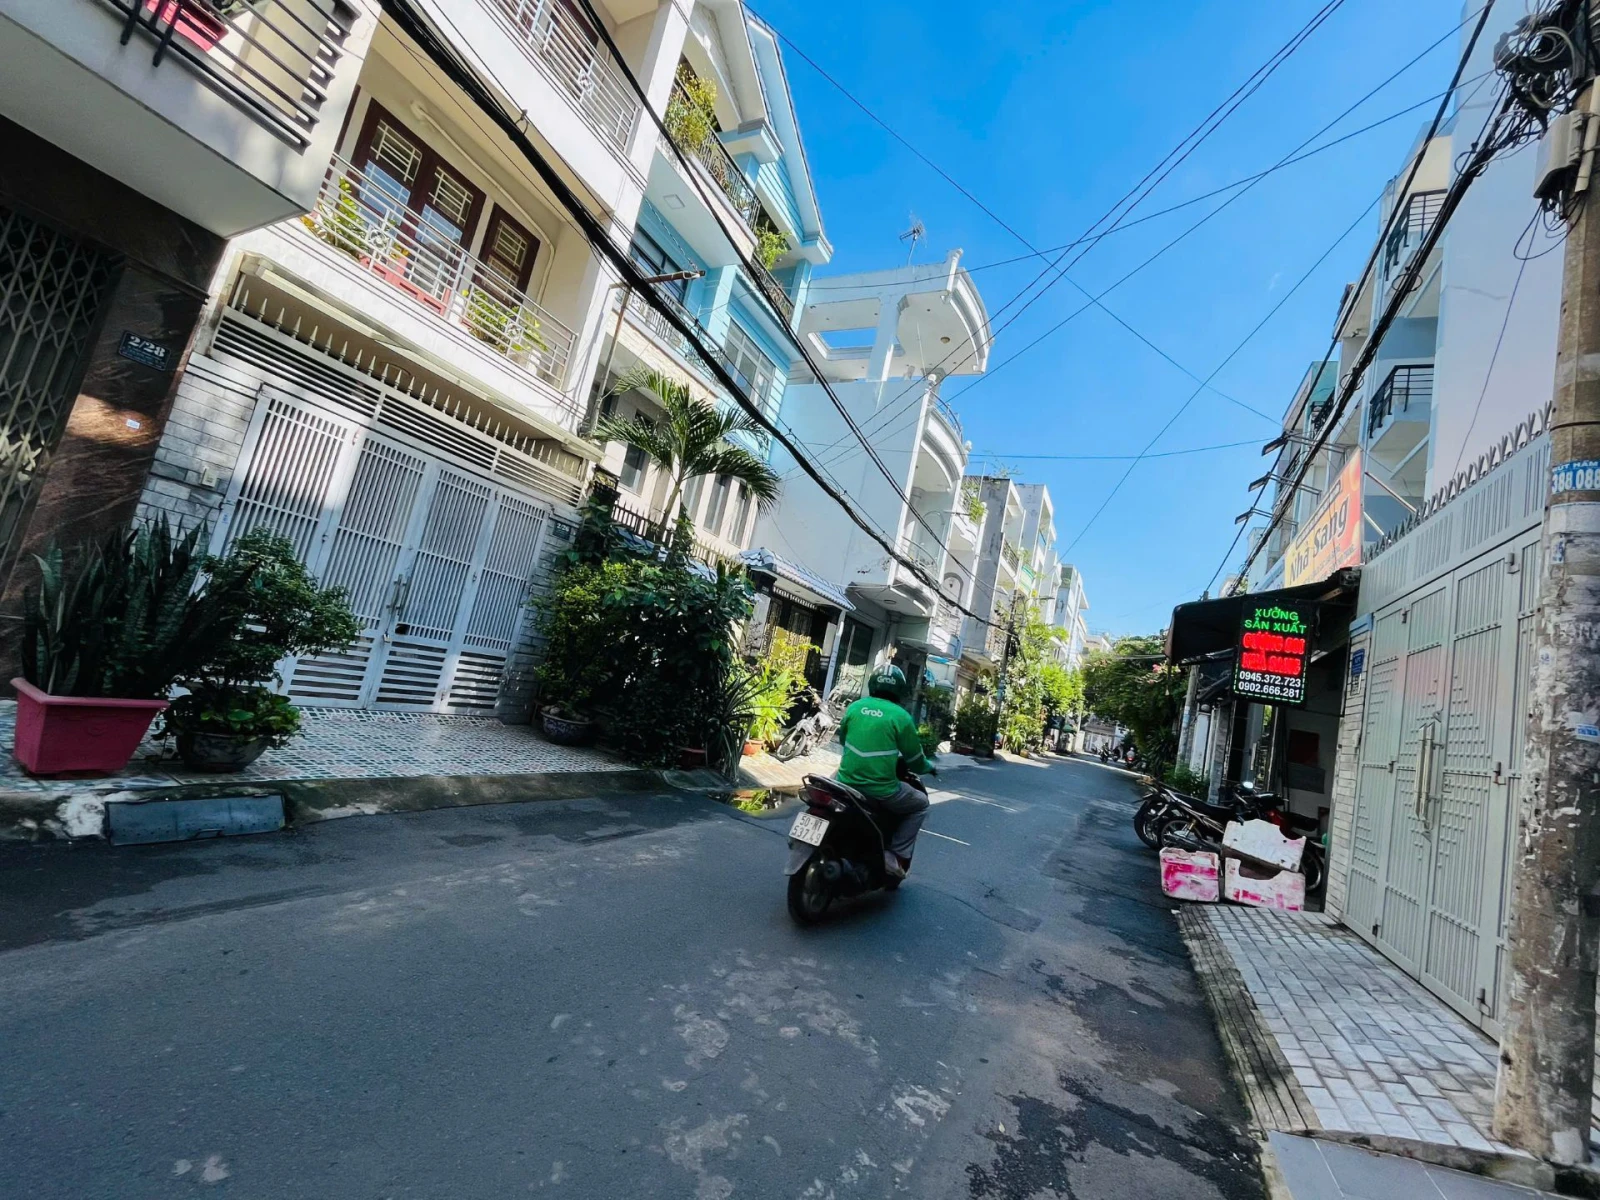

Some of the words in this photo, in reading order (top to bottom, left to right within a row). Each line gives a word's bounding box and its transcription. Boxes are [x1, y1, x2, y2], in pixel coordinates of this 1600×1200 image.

[128, 335, 166, 357] 2/28
[1313, 496, 1349, 559] Sang
[1254, 606, 1299, 621] XƯỞNG
[1244, 617, 1270, 630] SẢN
[1273, 620, 1307, 634] XUẤT
[876, 675, 897, 685] Grab
[1239, 670, 1302, 688] 0945.372.723
[1238, 681, 1301, 698] 0902.666.281
[860, 706, 884, 718] Grab
